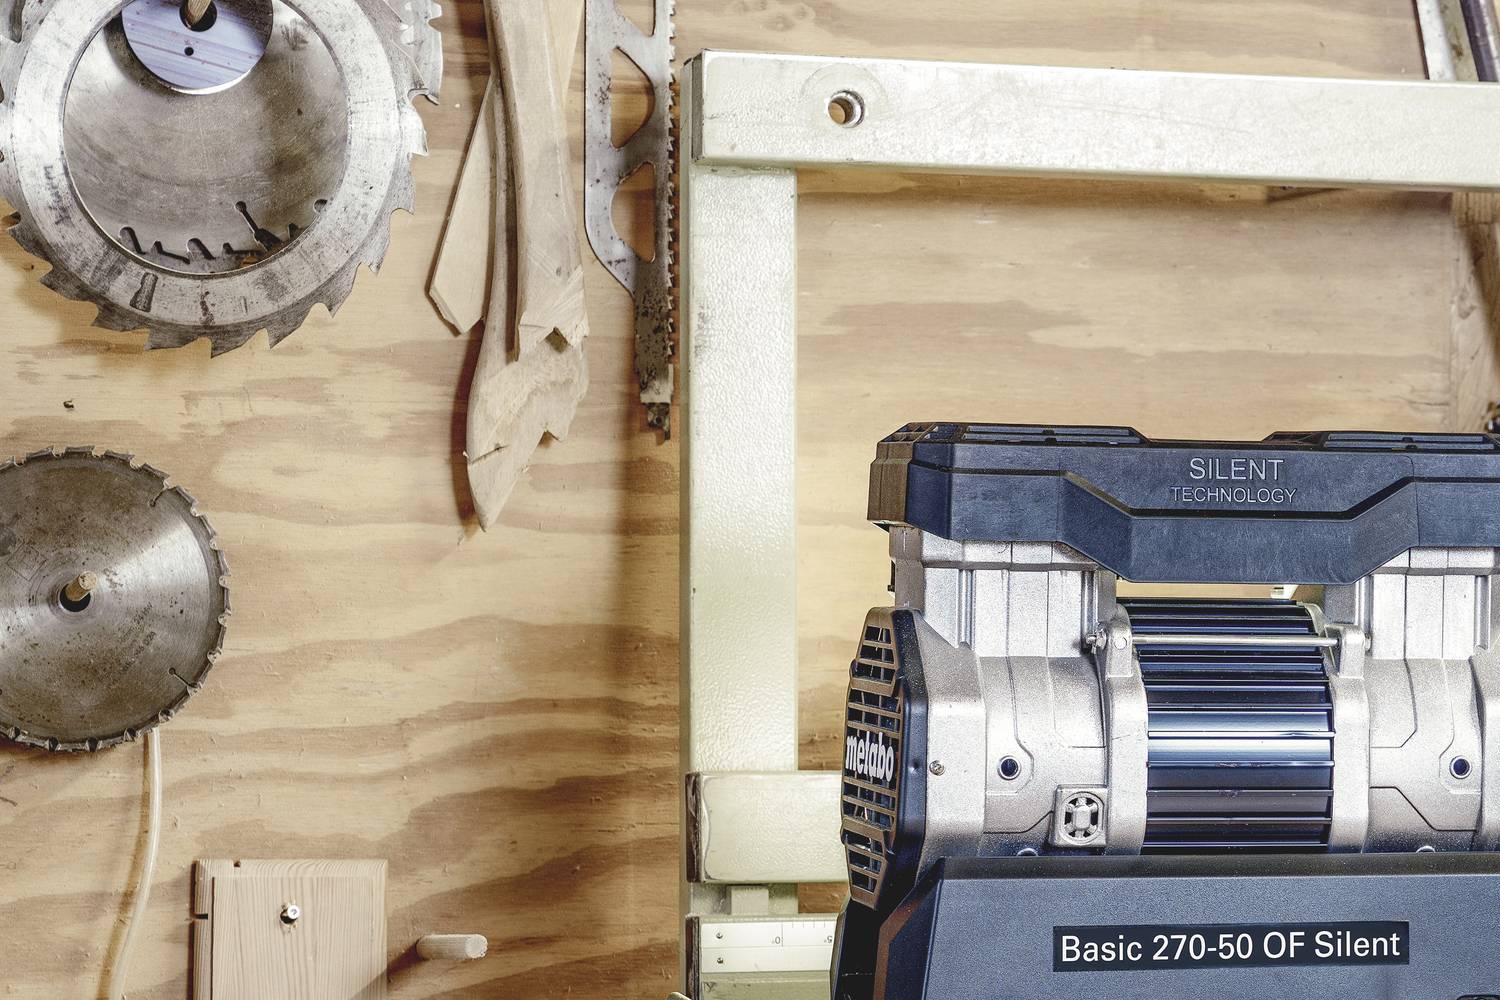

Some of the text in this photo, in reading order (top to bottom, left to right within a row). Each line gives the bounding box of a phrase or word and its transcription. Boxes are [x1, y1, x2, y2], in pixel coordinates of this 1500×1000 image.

[1189, 457, 1284, 481] SILENT
[1171, 486, 1297, 503] TECHNOLOGY
[845, 730, 895, 782] metabo
[1061, 930, 1401, 962] Basic 270-50 OF Silent
